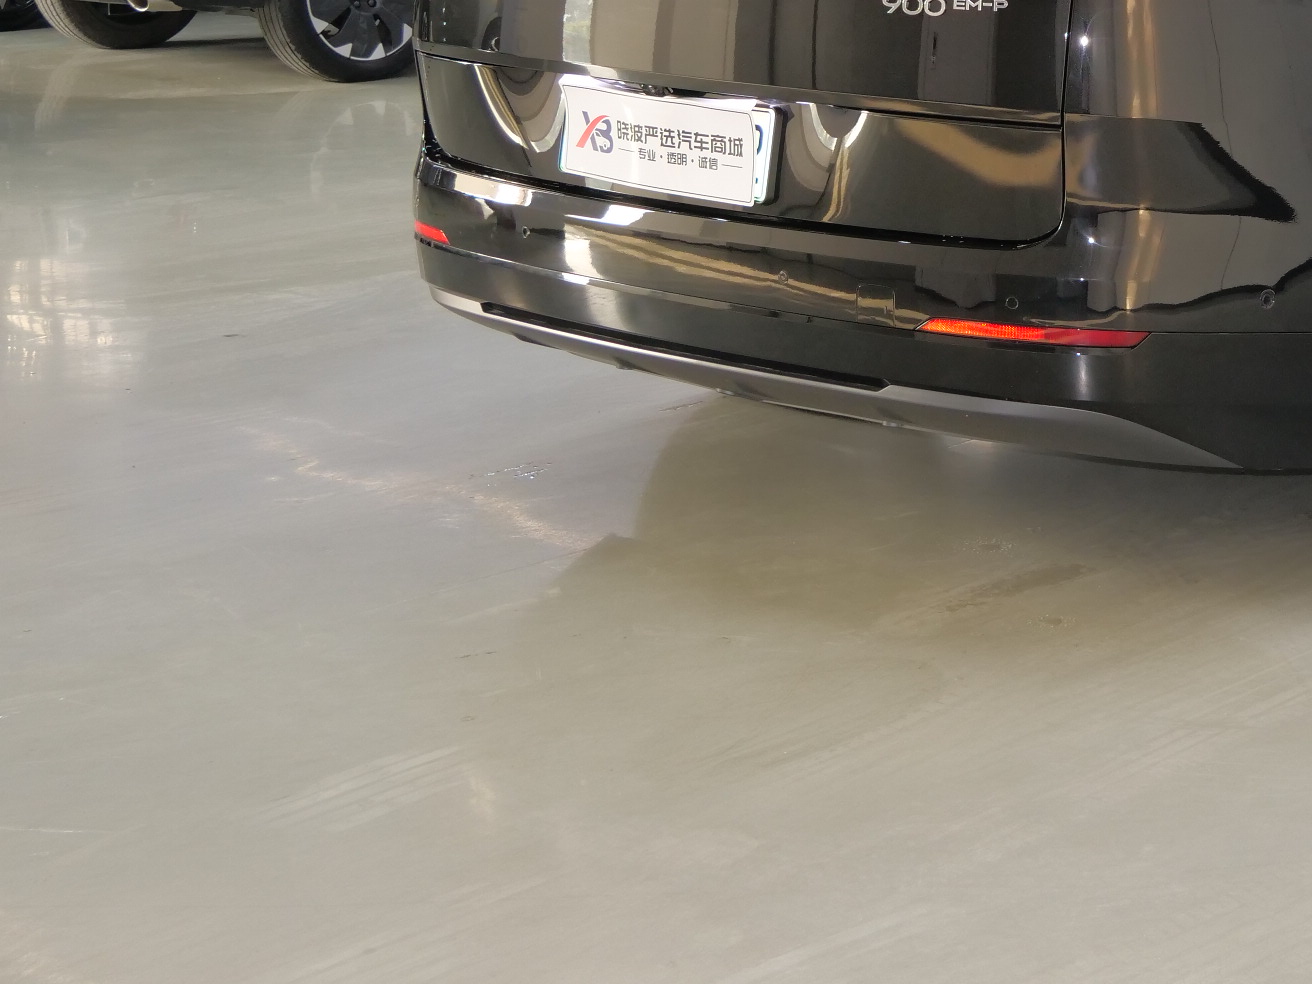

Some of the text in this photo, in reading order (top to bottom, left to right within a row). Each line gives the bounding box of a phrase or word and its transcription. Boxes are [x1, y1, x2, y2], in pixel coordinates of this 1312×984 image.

[616, 119, 744, 158] 晓波严选汽车商城
